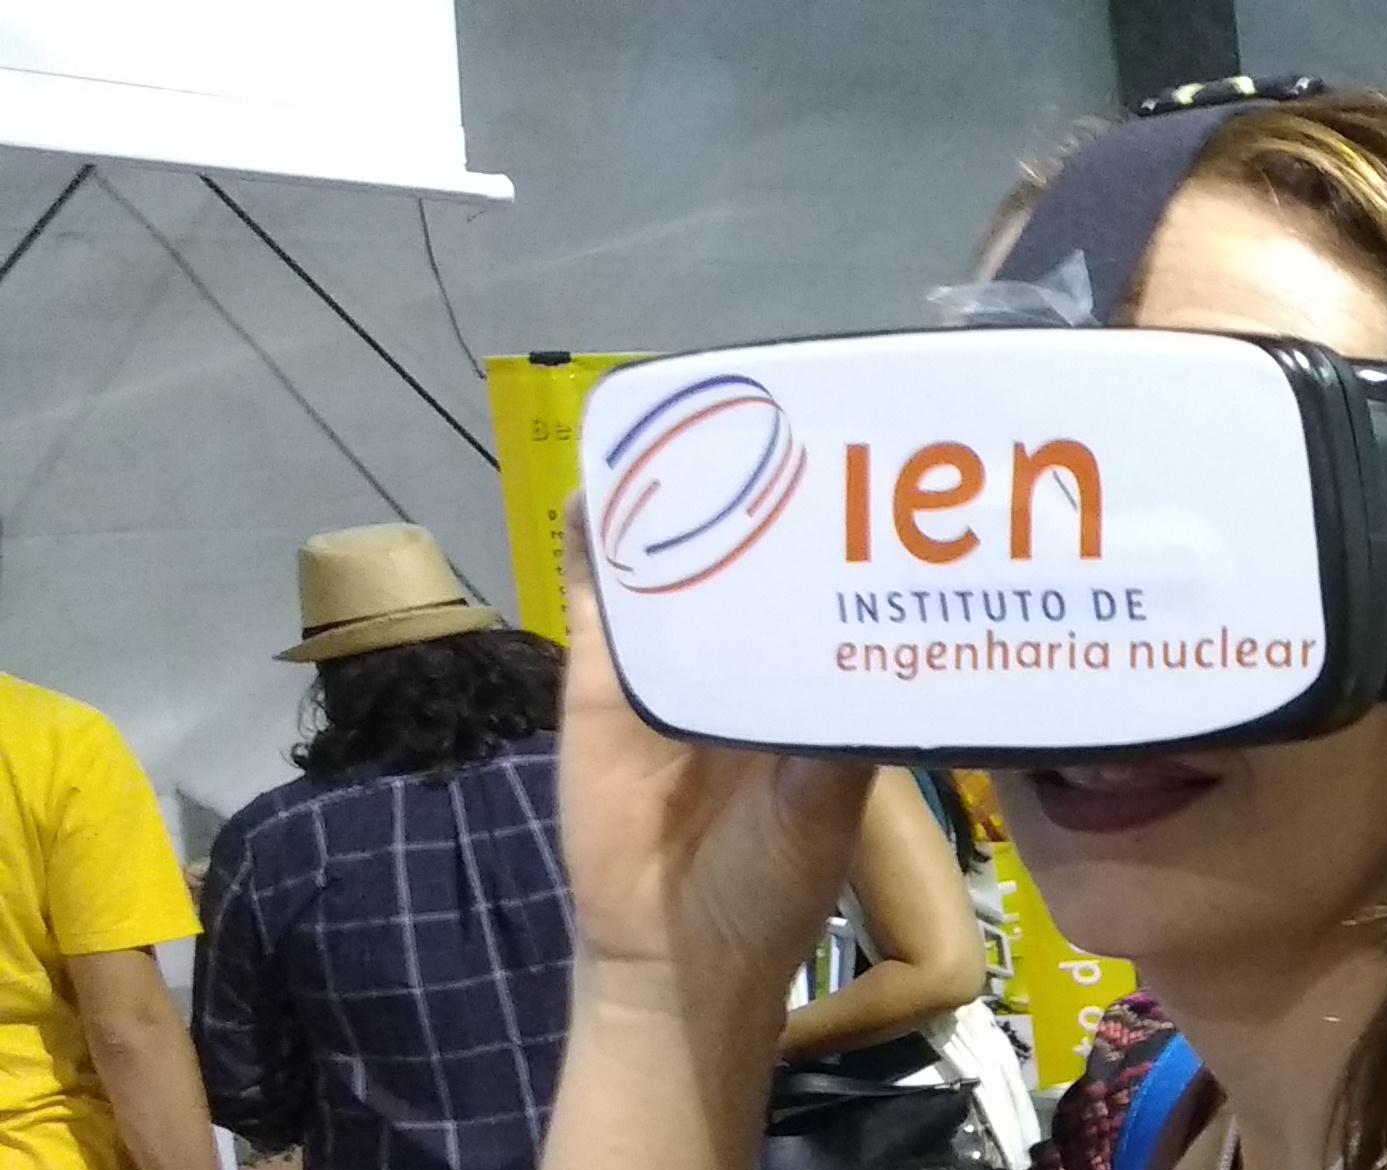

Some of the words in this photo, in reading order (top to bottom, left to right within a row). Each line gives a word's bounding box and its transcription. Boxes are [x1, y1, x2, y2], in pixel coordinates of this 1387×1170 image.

[836, 589, 1067, 624] INSTITUTO
[1091, 587, 1147, 622] DE
[836, 629, 1110, 681] engenharia
[1129, 625, 1317, 670] nuclear
